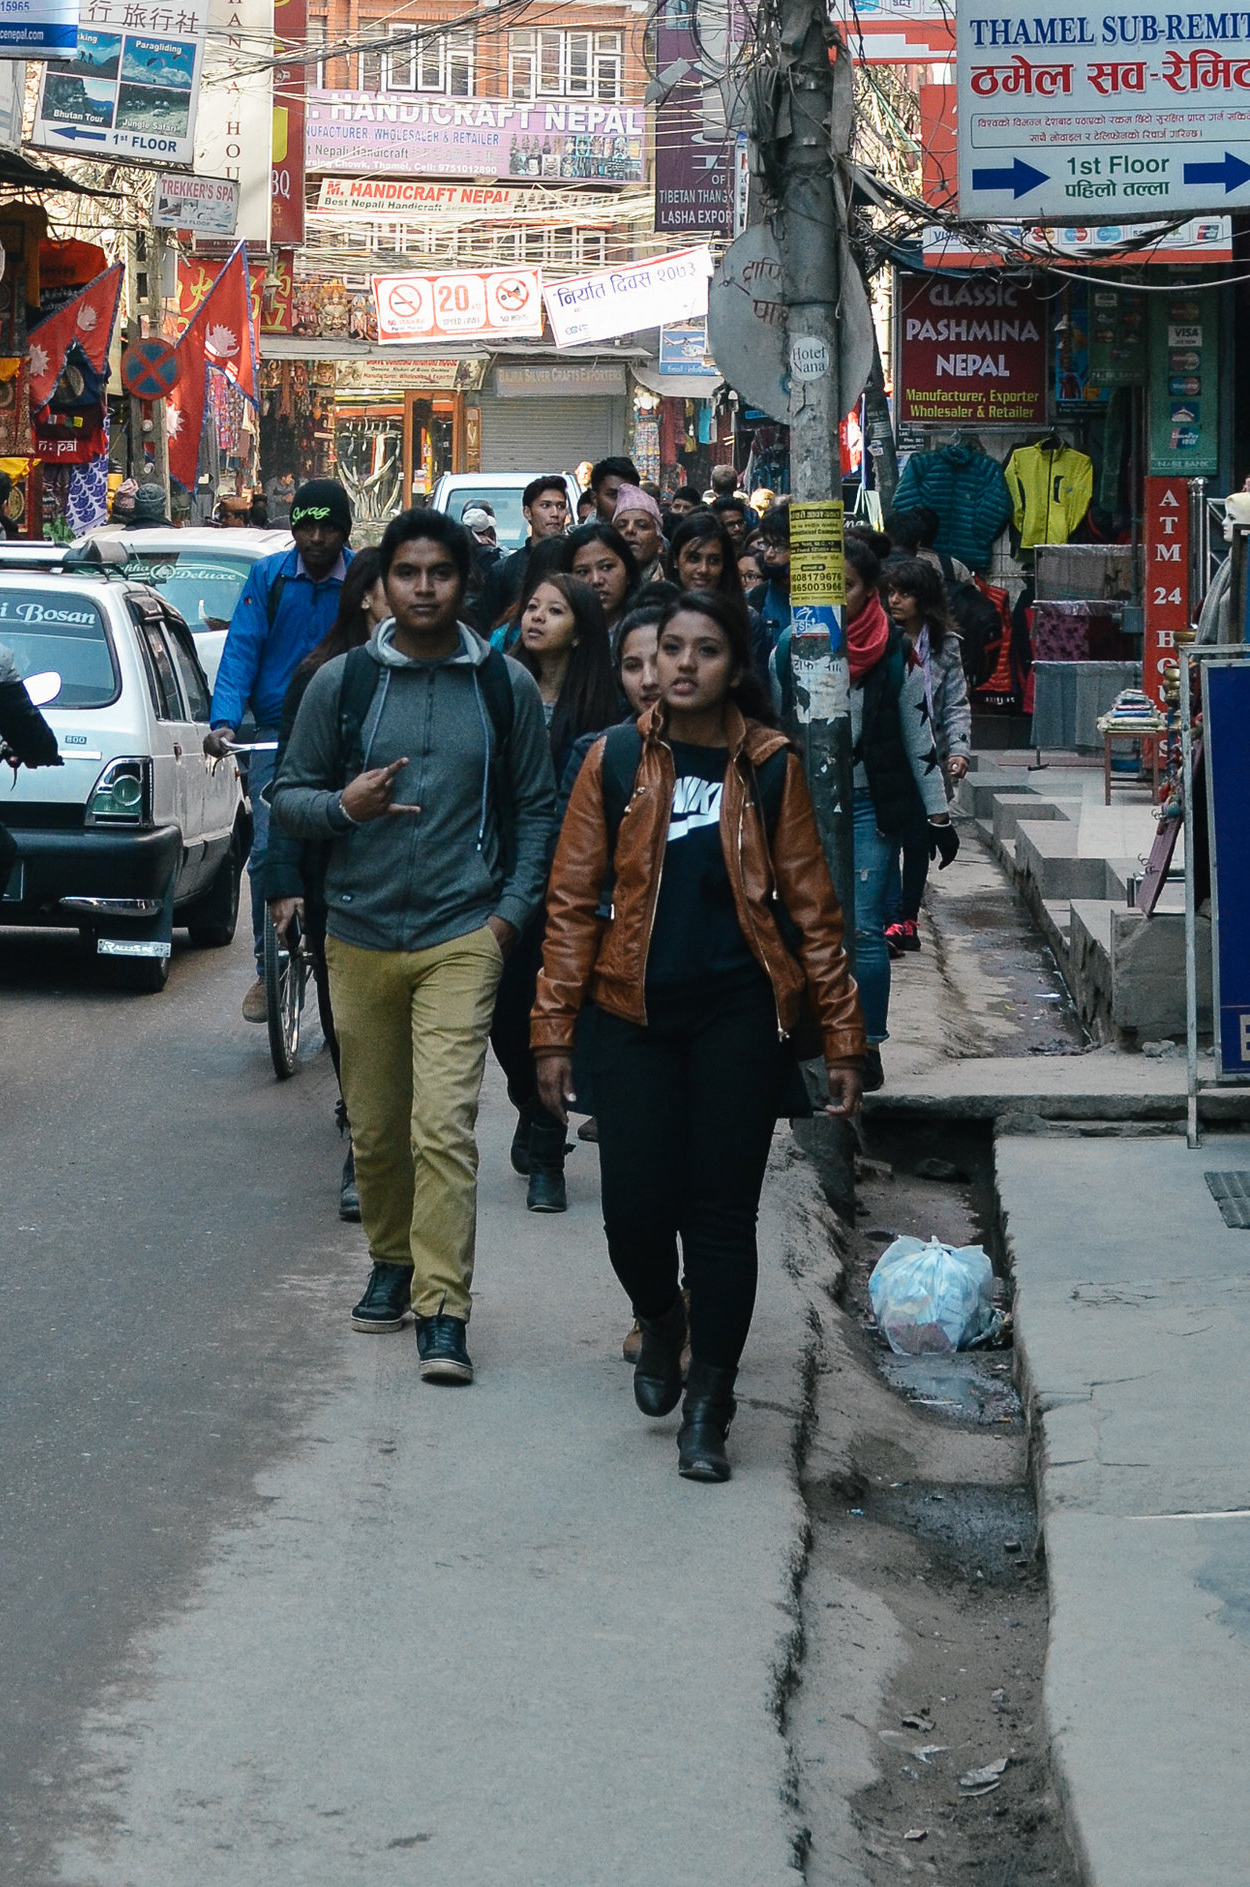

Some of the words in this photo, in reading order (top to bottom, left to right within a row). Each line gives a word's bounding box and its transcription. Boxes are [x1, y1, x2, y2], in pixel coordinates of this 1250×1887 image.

[122, 3, 200, 35] 旅行社
[969, 16, 1095, 47] THAMEL
[135, 39, 183, 55] Paragliding
[969, 54, 1075, 96] ठमेल
[53, 109, 84, 122] Bhutan
[85, 112, 105, 124] Tour
[330, 92, 536, 130] HANDICRAFT
[544, 103, 645, 135] NEPAL
[112, 133, 129, 147] 1st
[131, 136, 178, 153] FLOOR
[373, 127, 440, 143] WHOLESALER
[452, 131, 500, 147] RETAILER
[1066, 156, 1101, 176] 1st
[1108, 155, 1170, 175] Floor
[711, 174, 726, 185] OF
[1064, 178, 1117, 199] पहिलो
[1123, 180, 1170, 197] तल्ला
[160, 178, 215, 201] TREKKER'S
[215, 183, 236, 202] SPA
[350, 181, 459, 203] HANDICRAFT
[659, 189, 696, 204] TIBETAN
[324, 196, 349, 209] Best
[661, 210, 696, 224] LASHA
[438, 284, 470, 313] 20
[928, 282, 1018, 308] CLASSIC
[905, 317, 1040, 343] PASHMINA
[1174, 327, 1199, 338] VISA
[935, 353, 1010, 378] NEPAL
[905, 388, 986, 403] Manufacturer,
[989, 389, 1039, 404] Exporter
[910, 404, 973, 419] Wholesaler
[988, 405, 1035, 419] Retailer
[1154, 488, 1182, 562] ATM
[1153, 586, 1182, 605] 24
[65, 735, 87, 745] 800
